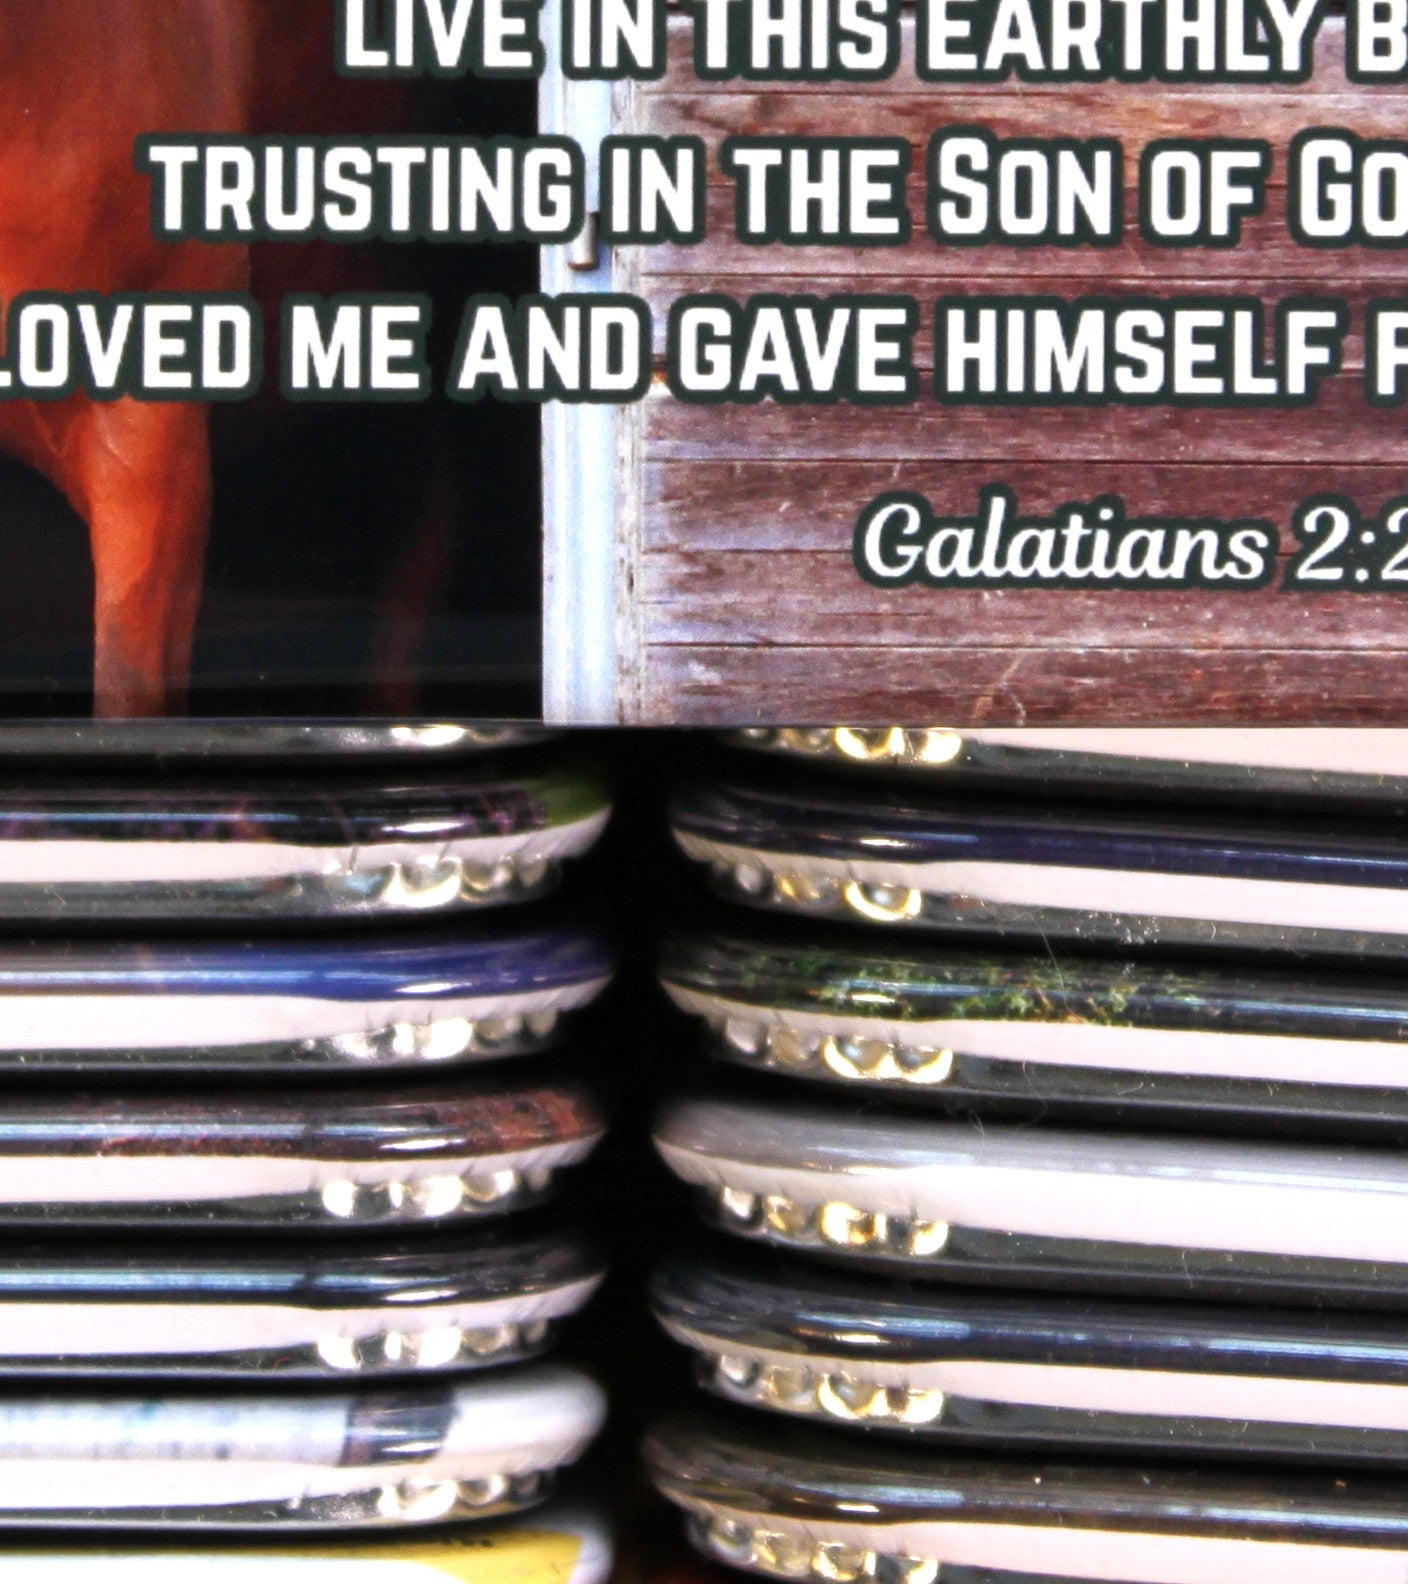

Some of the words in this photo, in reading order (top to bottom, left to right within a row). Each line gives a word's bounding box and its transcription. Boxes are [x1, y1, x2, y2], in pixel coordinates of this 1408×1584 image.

[148, 145, 572, 233] TRUSTING
[611, 147, 695, 234] IN
[732, 147, 900, 235] THE
[1150, 150, 1261, 237] OF
[291, 305, 421, 390] ME
[457, 305, 640, 391] AND
[679, 306, 907, 393] GAVE
[946, 307, 1337, 395] HIMSELF
[863, 496, 1269, 581] Galatians
